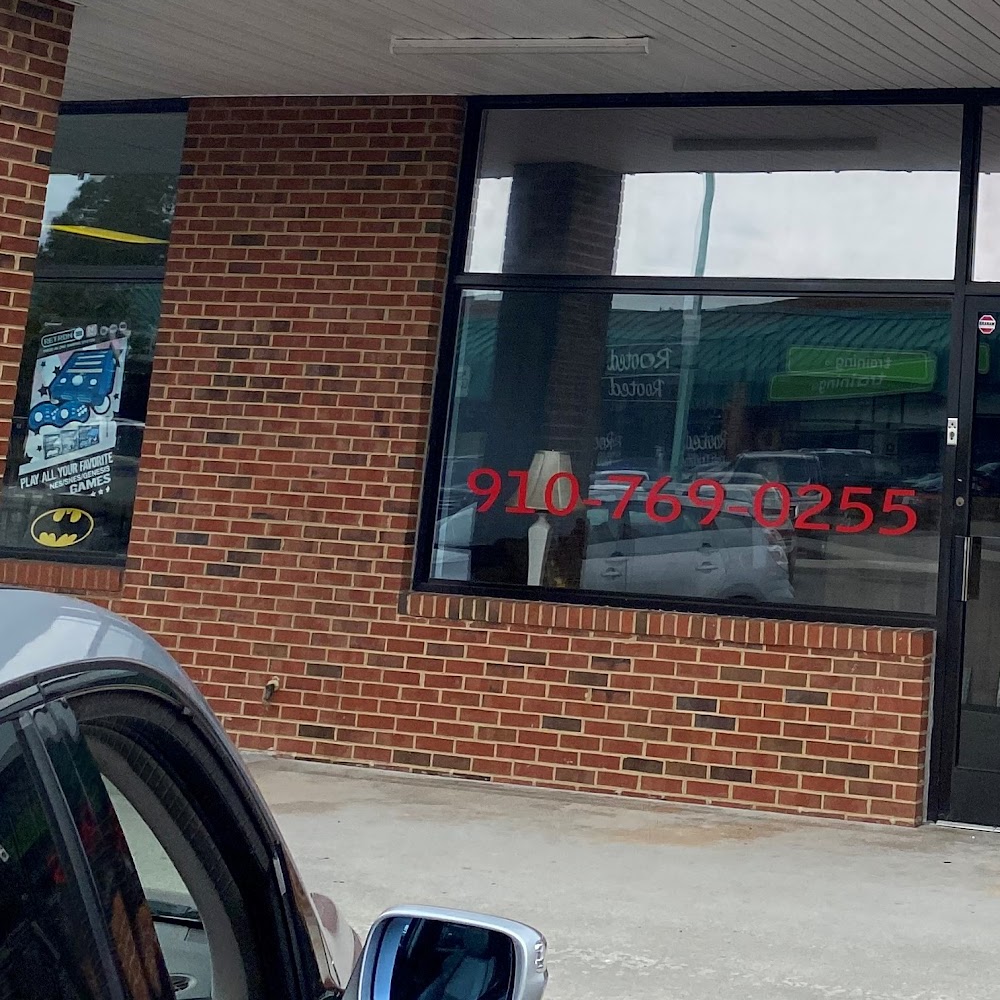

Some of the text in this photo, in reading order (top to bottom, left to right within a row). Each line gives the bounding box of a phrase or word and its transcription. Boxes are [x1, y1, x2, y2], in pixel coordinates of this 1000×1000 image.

[20, 452, 114, 490] PLAY ALL YOUR FAVORITE
[69, 473, 112, 494] GAMES
[466, 467, 918, 536] 910-769-0255
